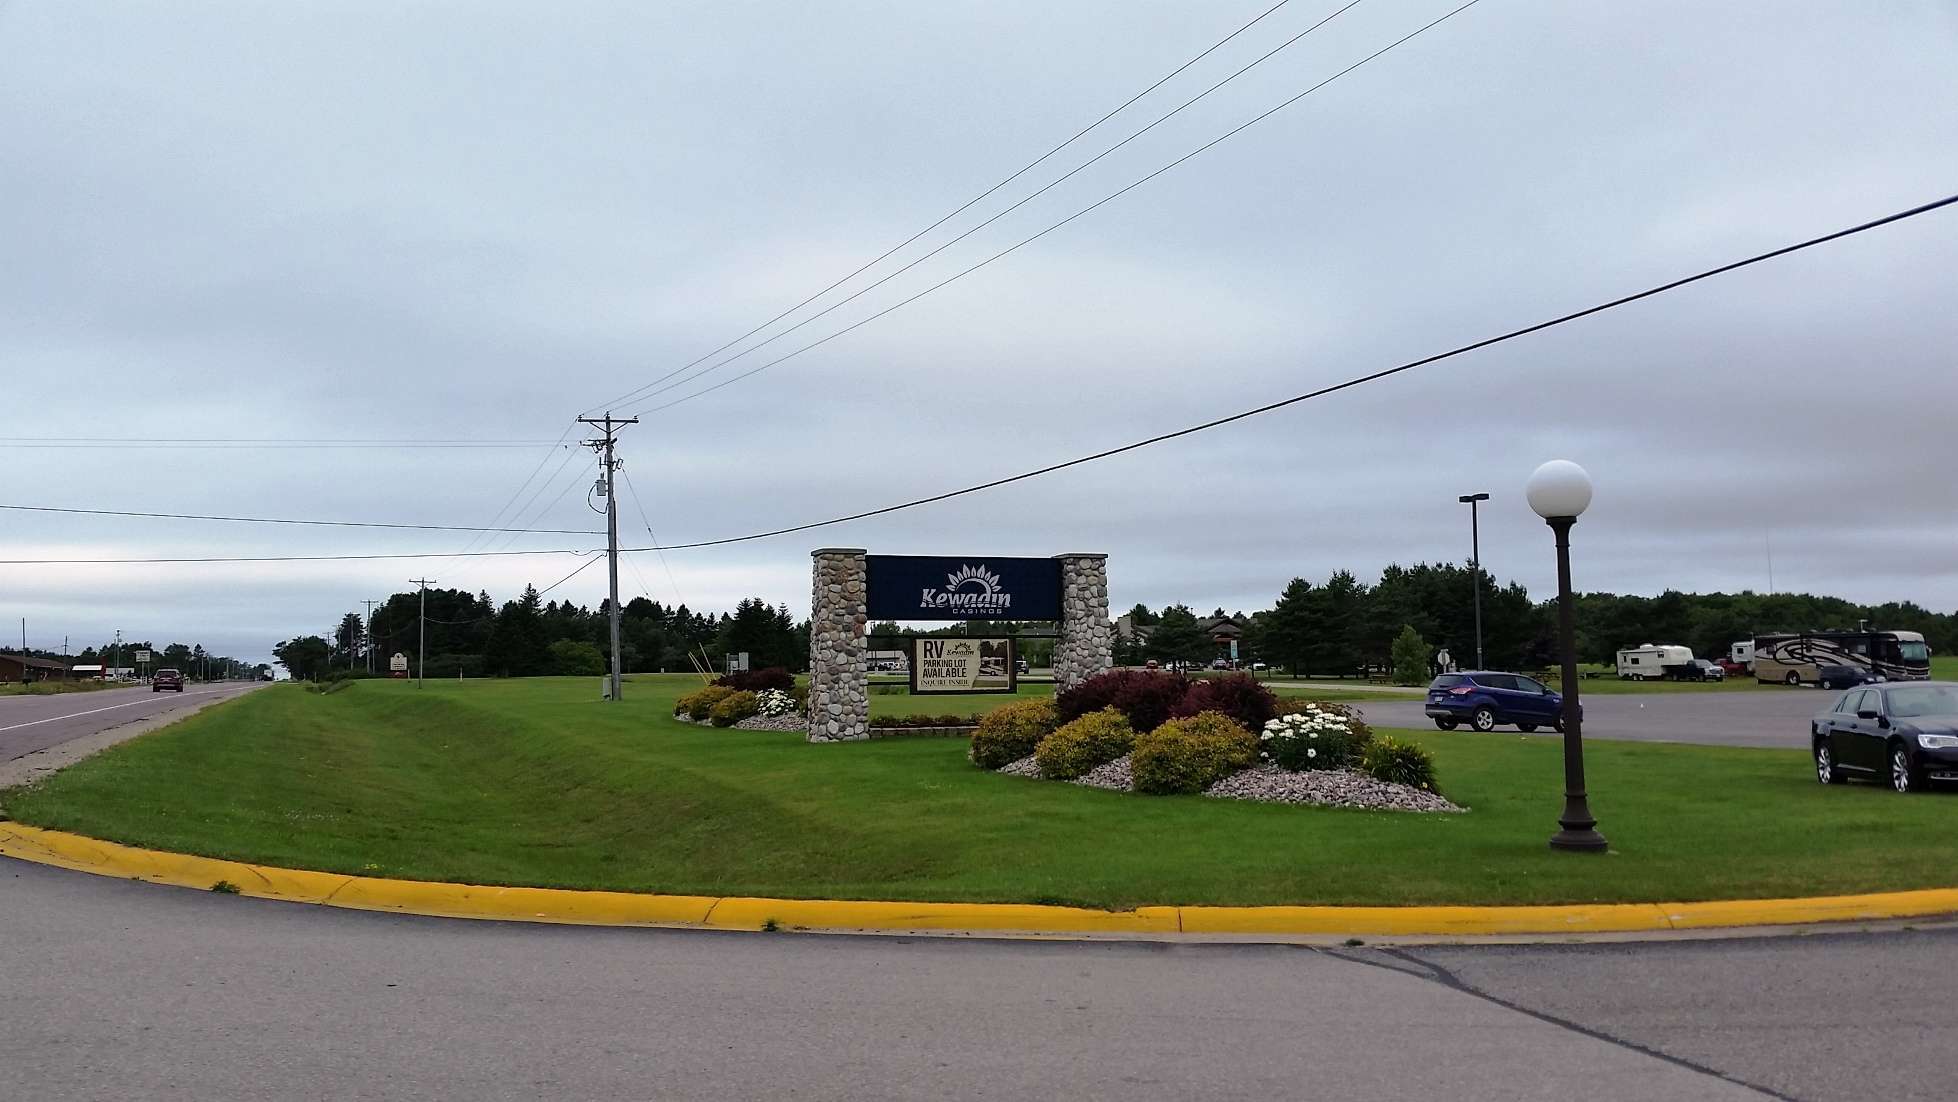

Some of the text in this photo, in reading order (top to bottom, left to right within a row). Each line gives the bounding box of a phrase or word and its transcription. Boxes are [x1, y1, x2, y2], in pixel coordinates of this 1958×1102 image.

[920, 588, 1011, 608] Kewadin
[923, 640, 945, 659] RV
[923, 659, 967, 668] PARKING LOT
[922, 667, 967, 678] AVAILABLE
